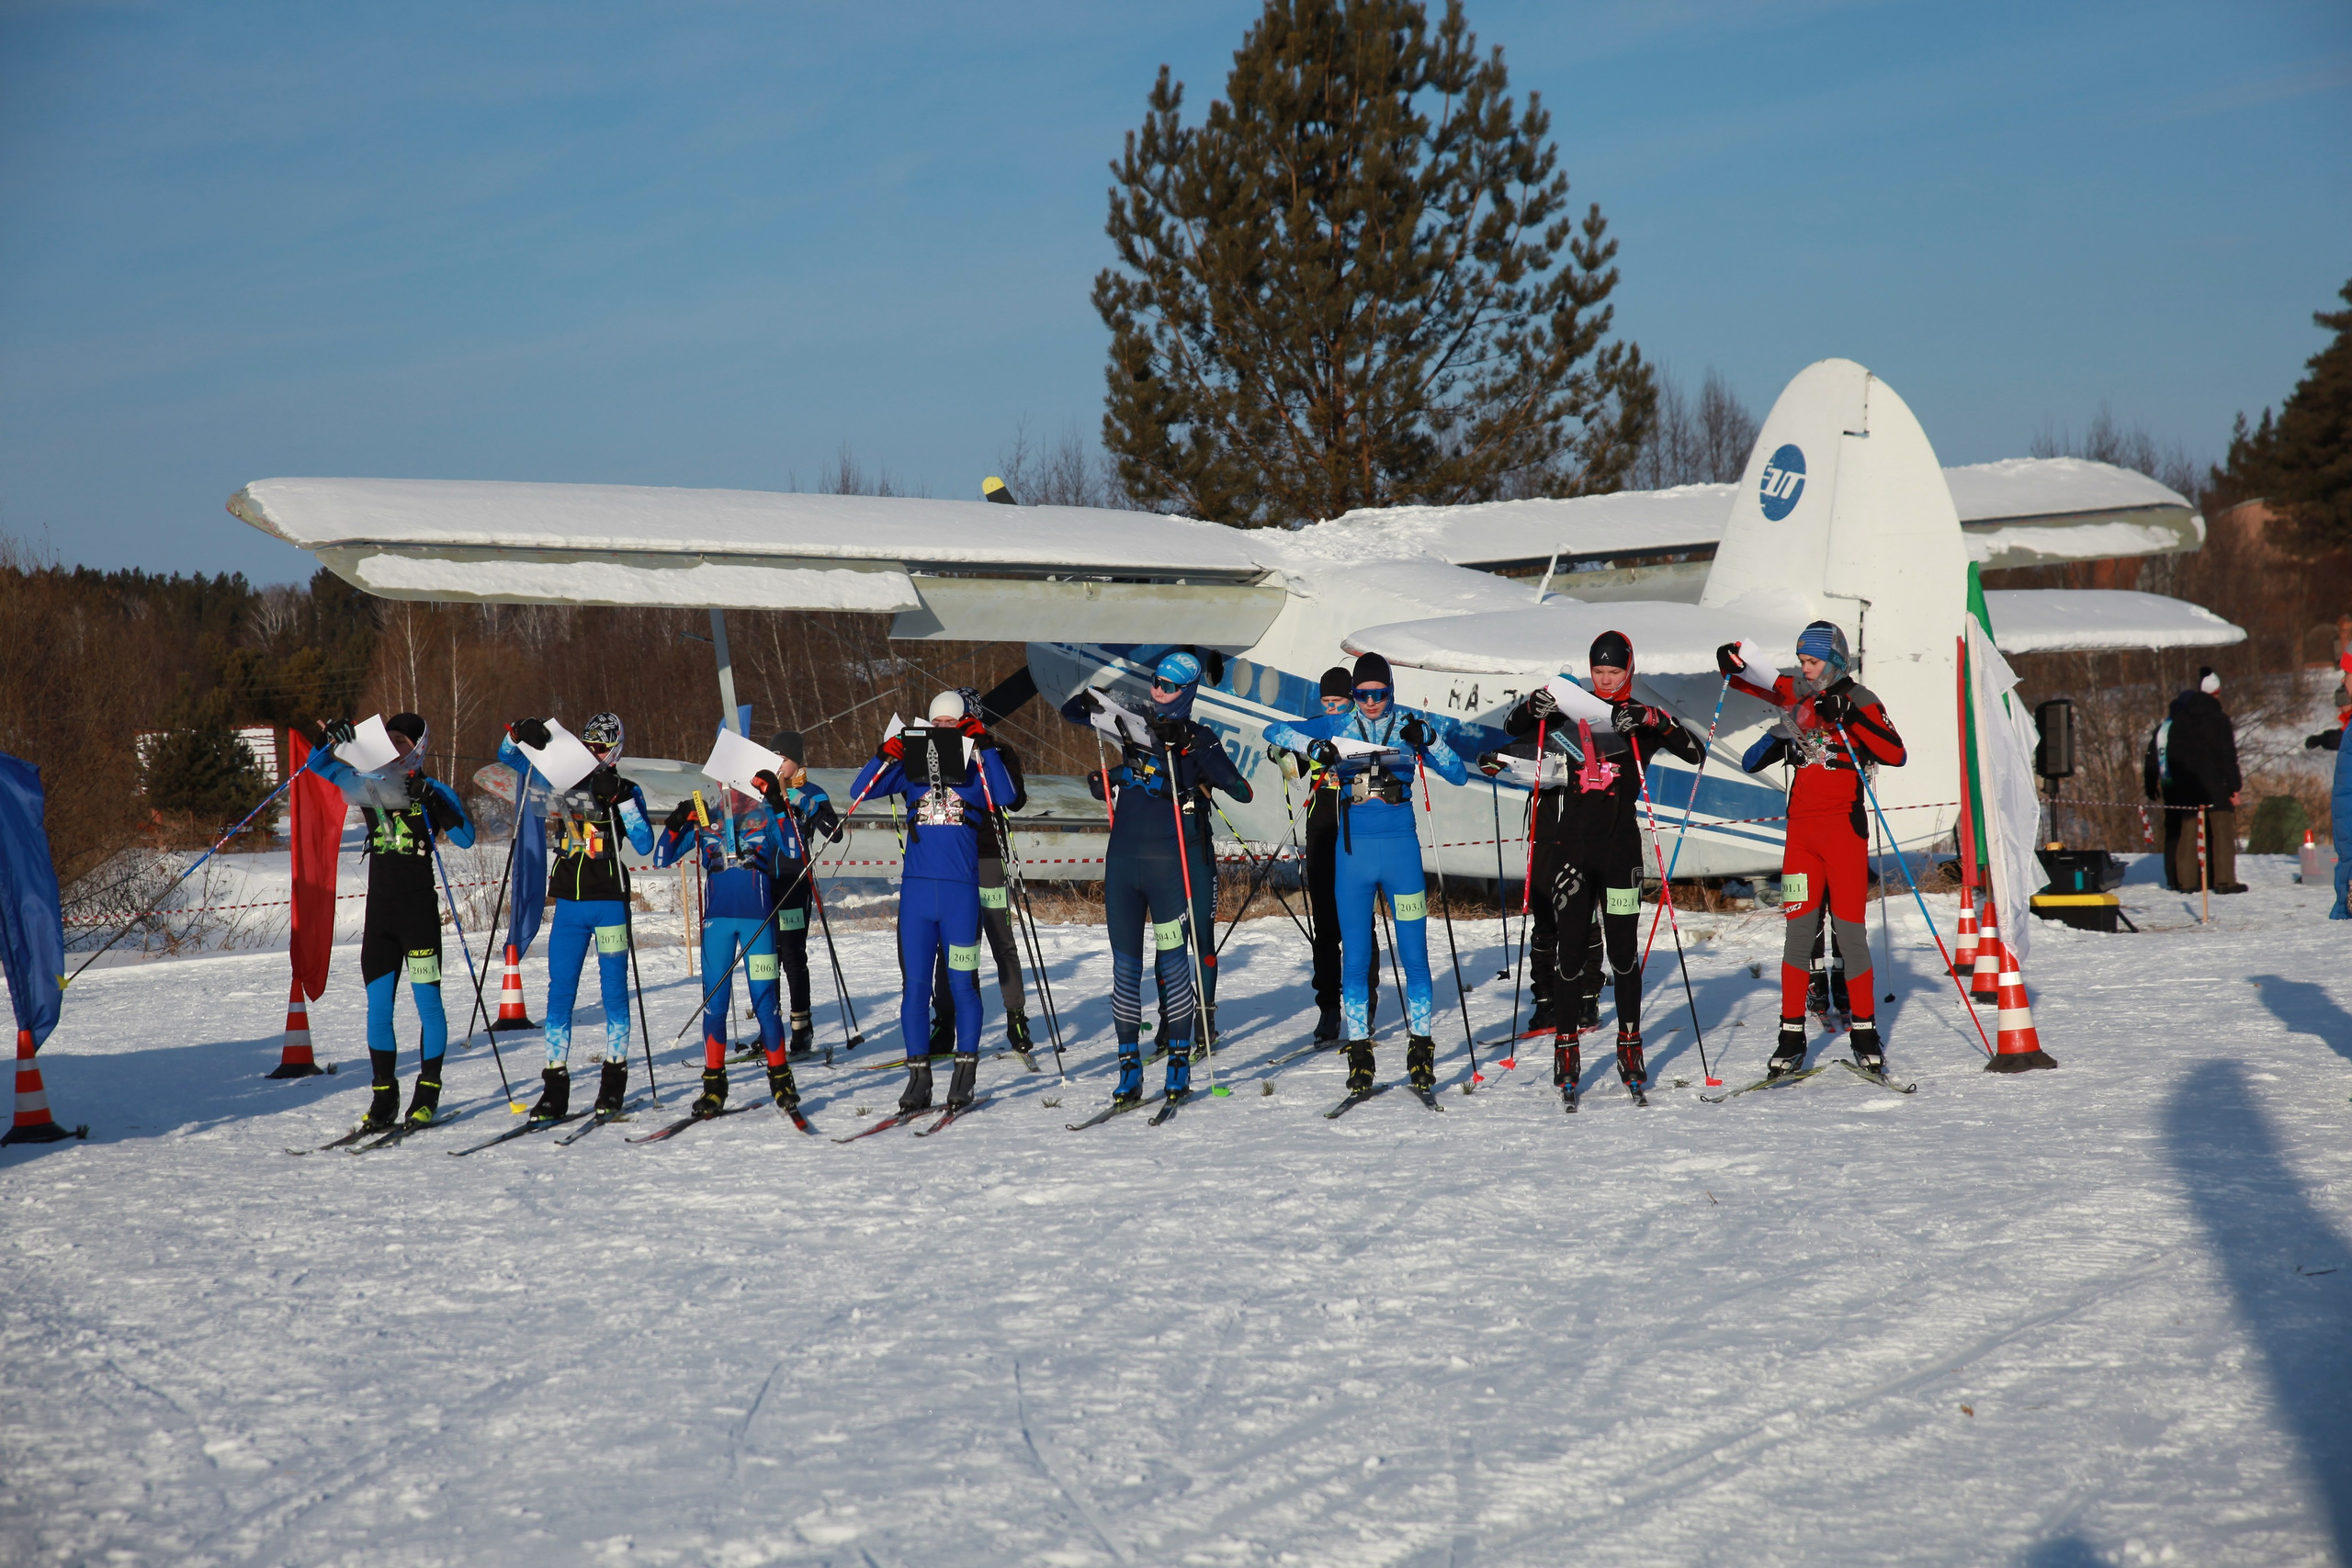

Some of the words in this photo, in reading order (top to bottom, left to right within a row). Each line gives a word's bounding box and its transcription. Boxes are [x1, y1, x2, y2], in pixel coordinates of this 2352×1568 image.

[1555, 733, 1584, 759] MAGNETO
[1782, 884, 1801, 893] 01.1
[983, 893, 1002, 902] 213.1
[1611, 897, 1634, 908] 202.1
[1400, 900, 1423, 912] 203.1
[600, 934, 623, 944] 207.1
[1155, 931, 1177, 942] 204.1
[954, 953, 977, 963] 205.1
[412, 965, 435, 975] 208.1
[754, 963, 777, 973] 206.1
